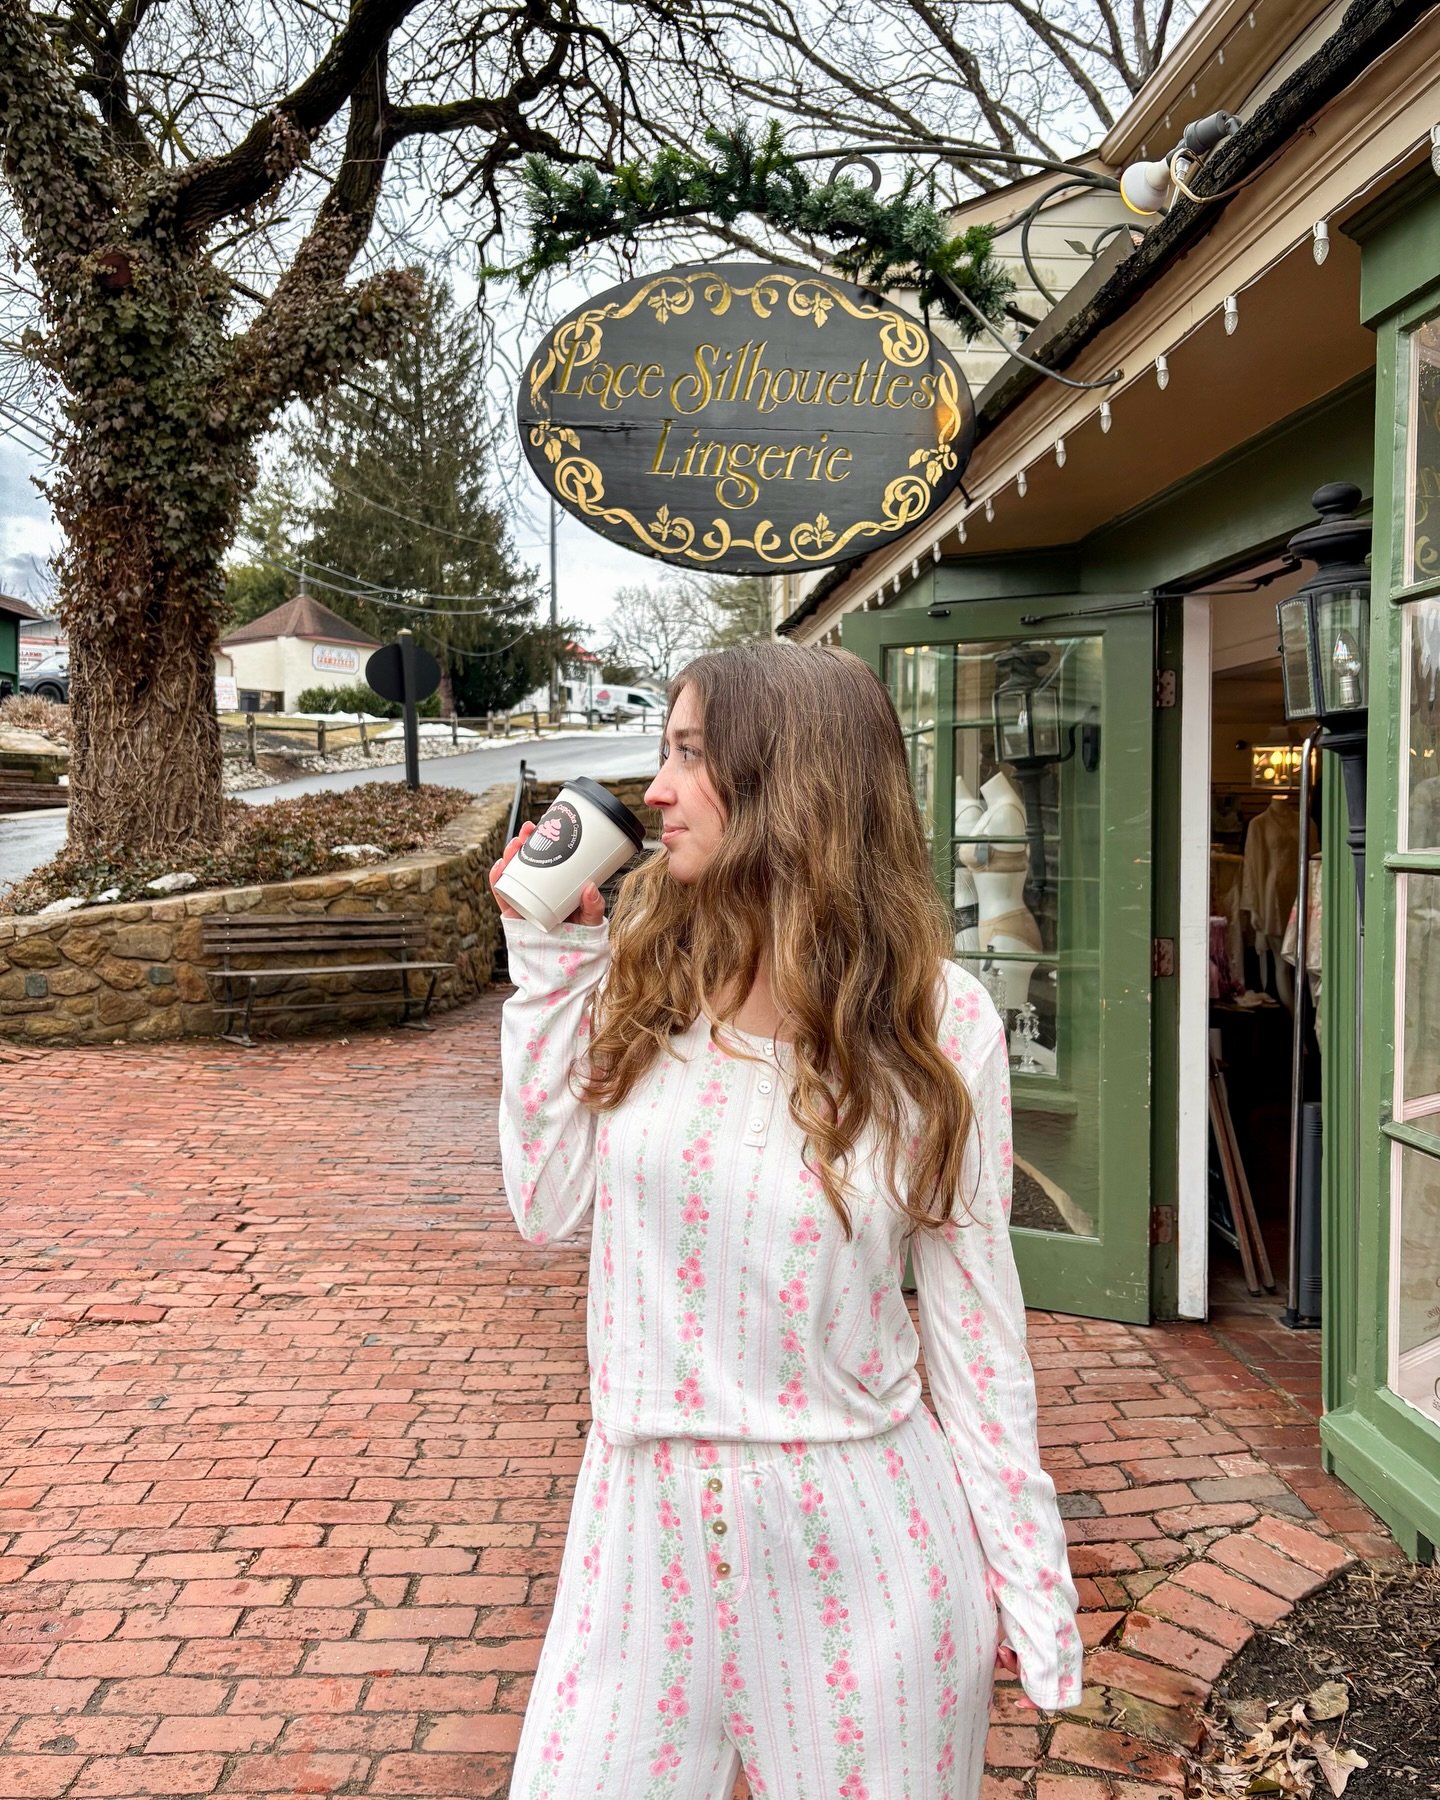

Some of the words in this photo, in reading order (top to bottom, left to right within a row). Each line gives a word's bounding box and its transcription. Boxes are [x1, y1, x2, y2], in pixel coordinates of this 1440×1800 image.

[550, 339, 665, 411] Lace
[670, 339, 936, 415] Silhouettes
[645, 418, 853, 510] Lingerie
[557, 804, 577, 824] Cupcake
[567, 824, 579, 849] Company
